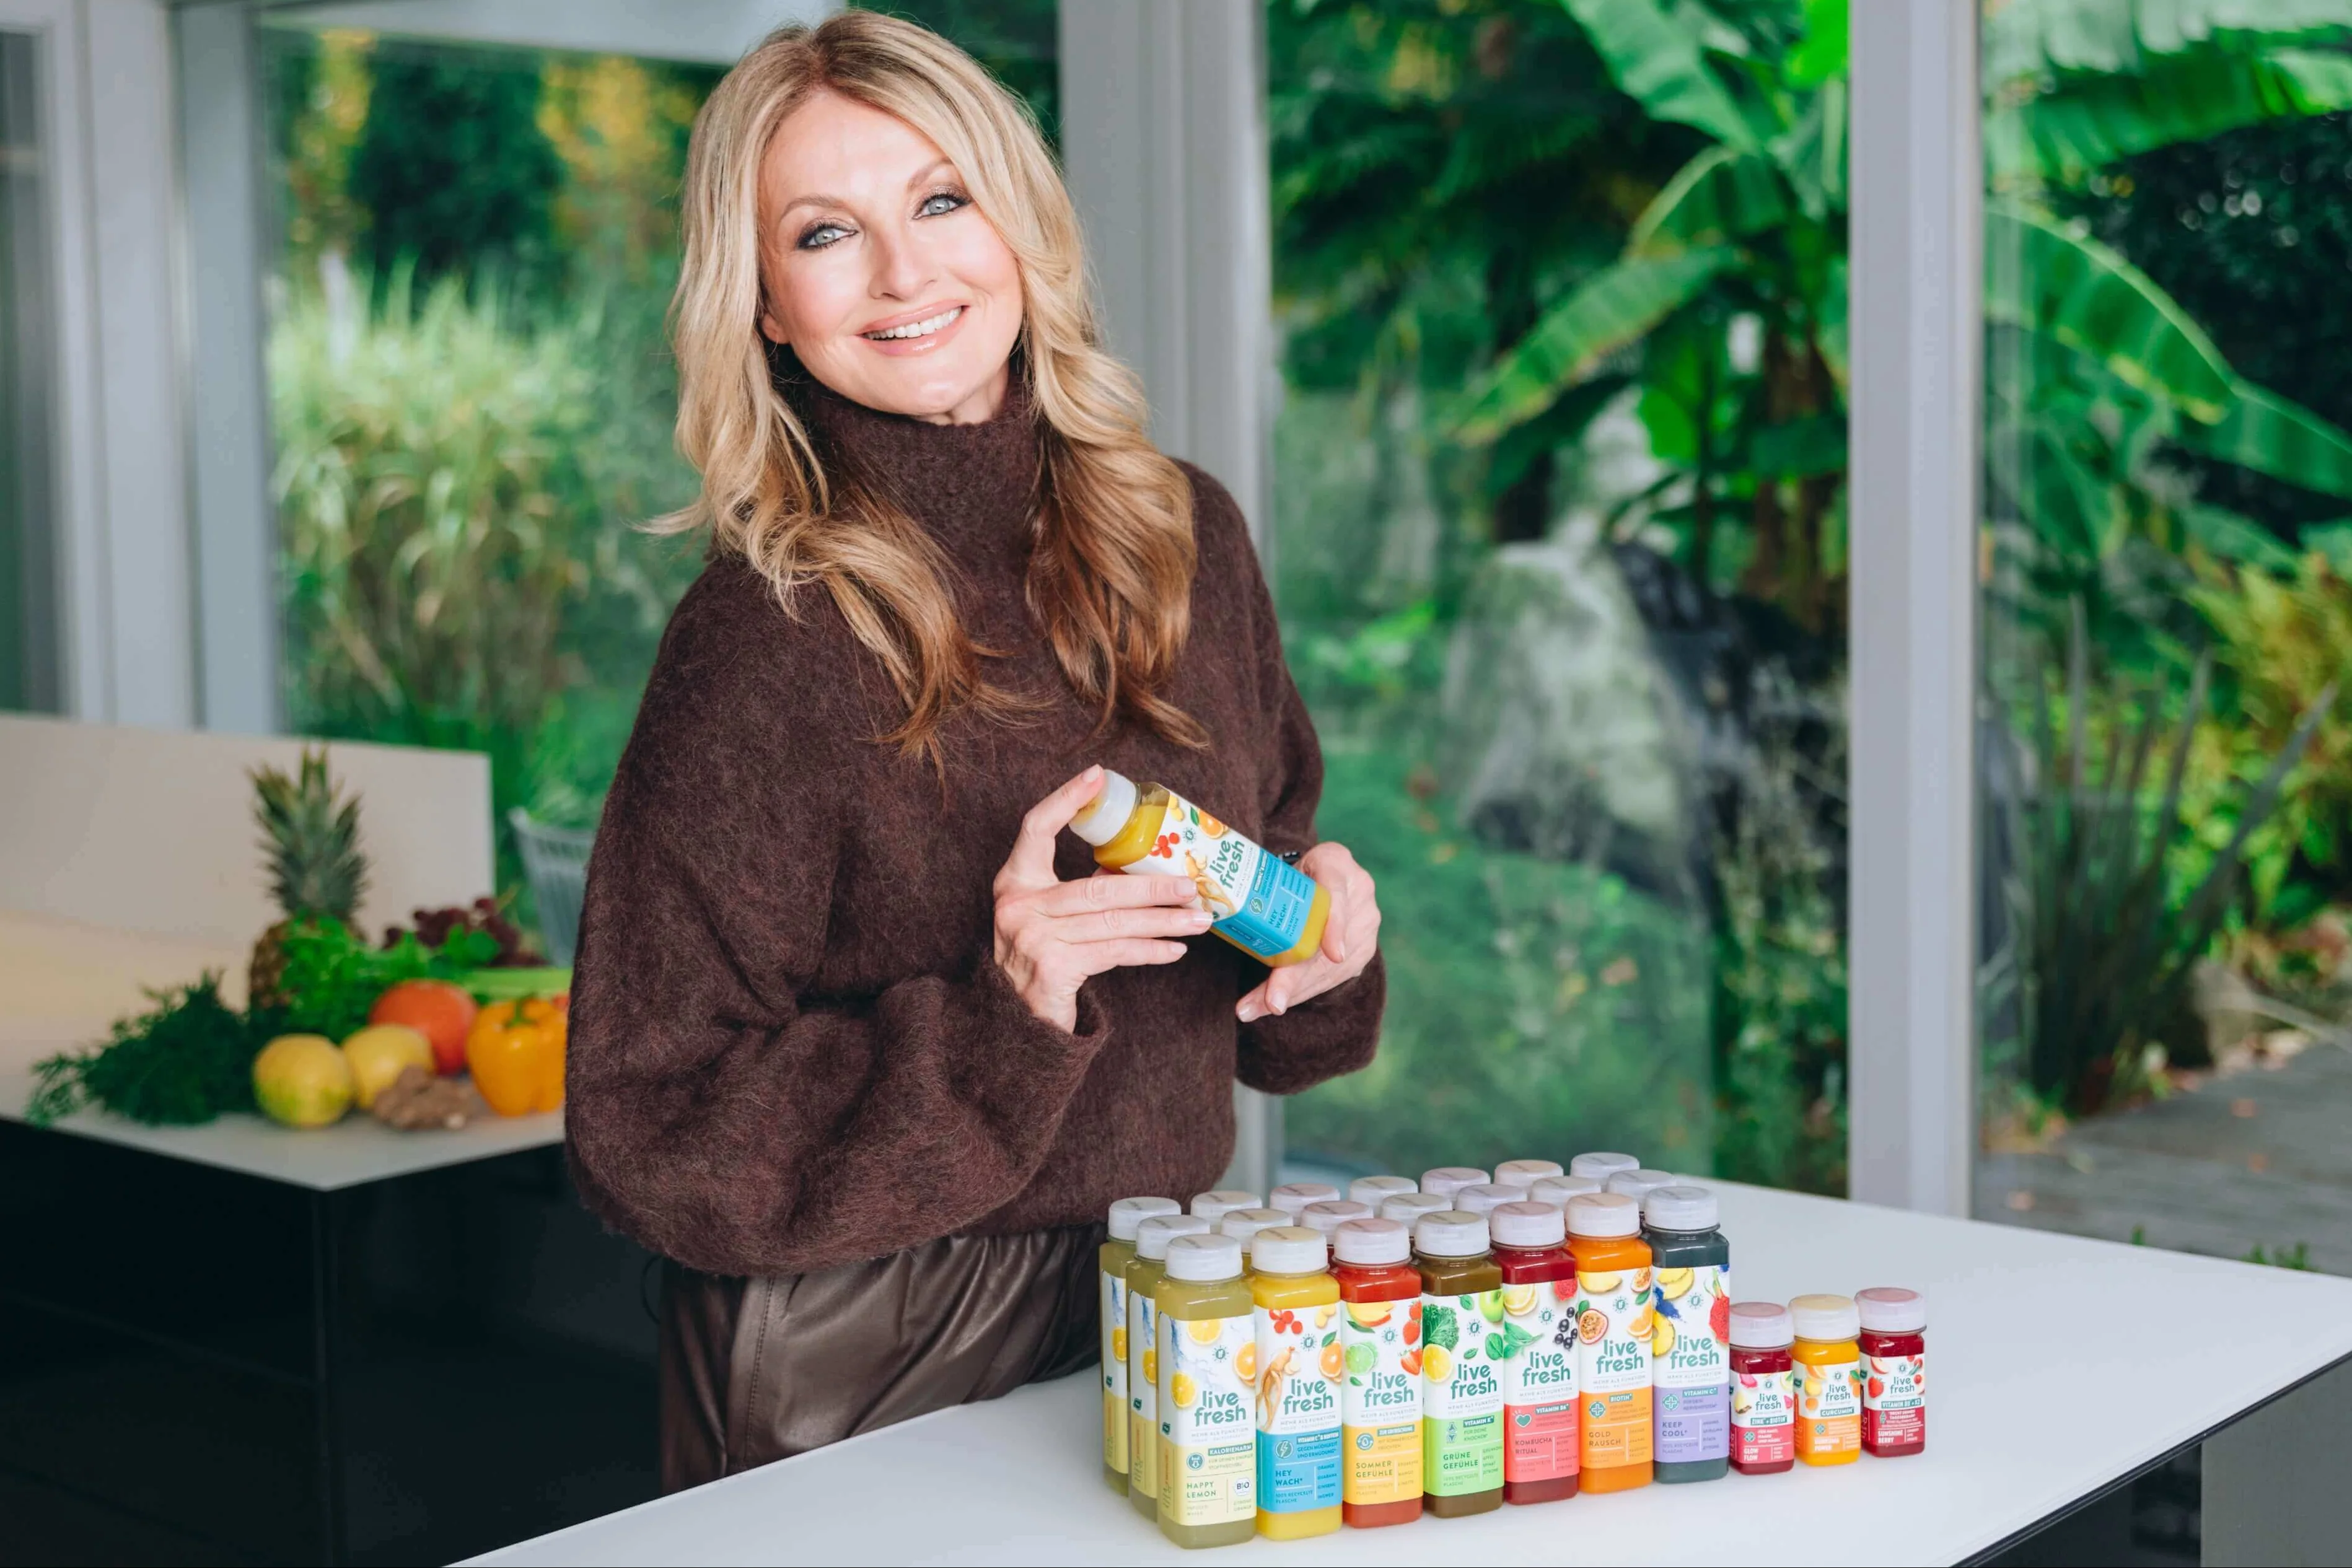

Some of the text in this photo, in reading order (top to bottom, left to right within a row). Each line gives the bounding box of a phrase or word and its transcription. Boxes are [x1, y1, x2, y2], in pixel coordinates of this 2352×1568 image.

[1209, 841, 1231, 875] live
[1219, 840, 1245, 889] fresh
[1269, 909, 1278, 925] HEY
[1604, 1339, 1637, 1357] live
[1677, 1334, 1713, 1352] live
[1530, 1351, 1564, 1369] live
[1596, 1353, 1644, 1374] fresh
[1670, 1349, 1719, 1369] fresh
[1458, 1364, 1491, 1381] live
[1522, 1365, 1570, 1386] fresh
[1291, 1378, 1326, 1396] live
[1372, 1372, 1407, 1390] live
[1450, 1377, 1497, 1399] fresh
[1829, 1384, 1846, 1392] live
[1890, 1384, 1915, 1394] fresh
[1893, 1377, 1911, 1385] live
[1203, 1390, 1239, 1408] live
[1283, 1393, 1333, 1414] fresh
[1364, 1385, 1414, 1408] fresh
[1759, 1393, 1778, 1401] live
[1826, 1391, 1850, 1402] fresh
[1536, 1406, 1559, 1414] VITAMIN
[1755, 1400, 1781, 1411] fresh
[1195, 1405, 1247, 1427] fresh
[1463, 1418, 1486, 1426] VITAMIN
[1515, 1437, 1552, 1445] KOMBUCHA
[1209, 1444, 1252, 1455] KALORIENARM
[1443, 1452, 1471, 1461] GRÜNE
[1356, 1460, 1392, 1468] SOMMER
[1443, 1459, 1478, 1469] GEFÜHLE
[1356, 1469, 1393, 1478] GEFÜHLE
[1187, 1491, 1216, 1499] LEMON
